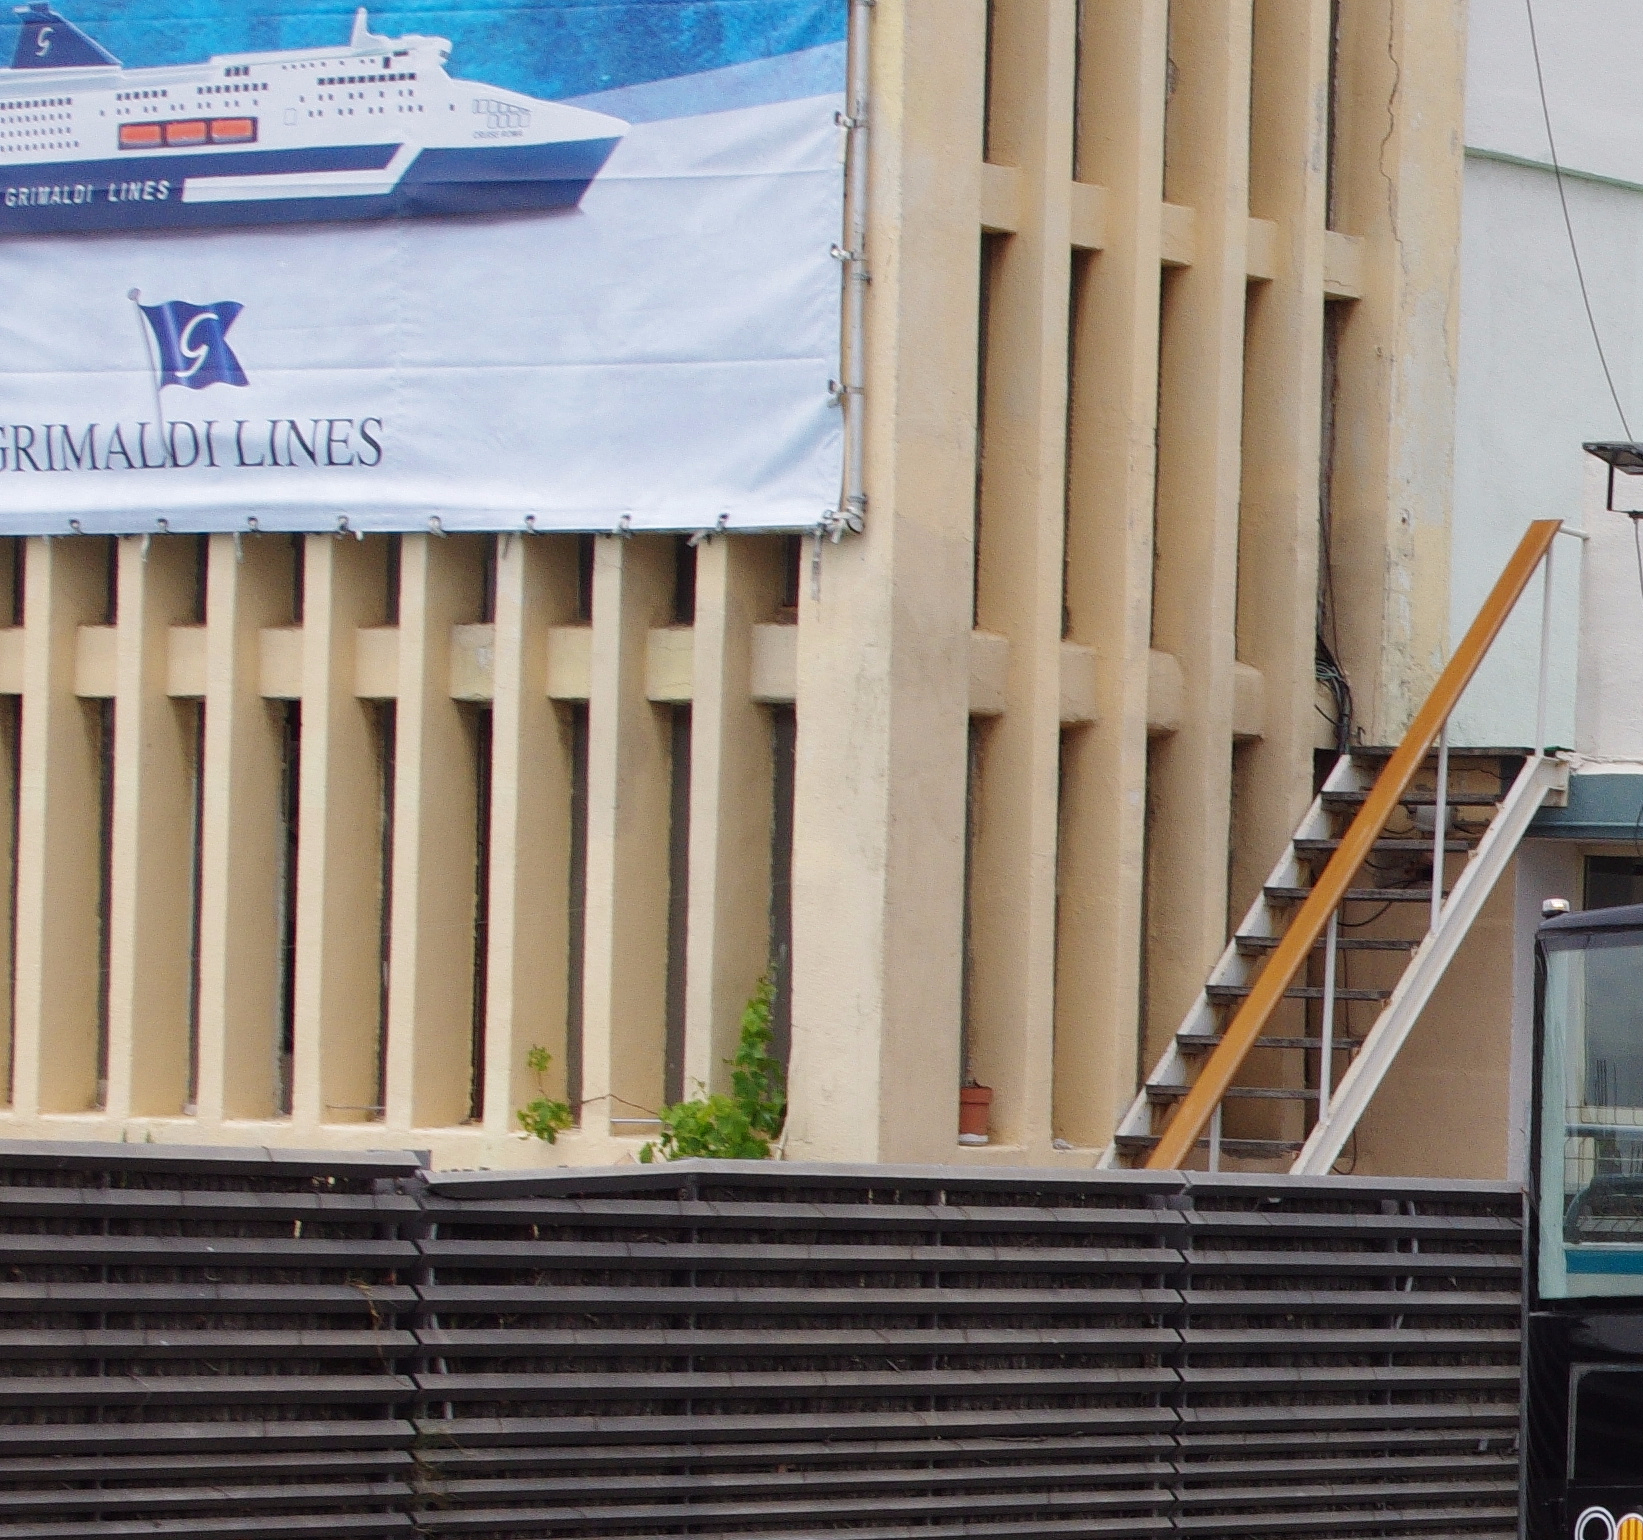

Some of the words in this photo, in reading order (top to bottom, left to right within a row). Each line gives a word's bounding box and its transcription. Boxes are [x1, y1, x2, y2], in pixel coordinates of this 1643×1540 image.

[5, 183, 94, 206] GRIMALDI
[107, 180, 170, 201] LINES
[0, 420, 221, 472] RIMALDI
[234, 417, 384, 468] LINES
